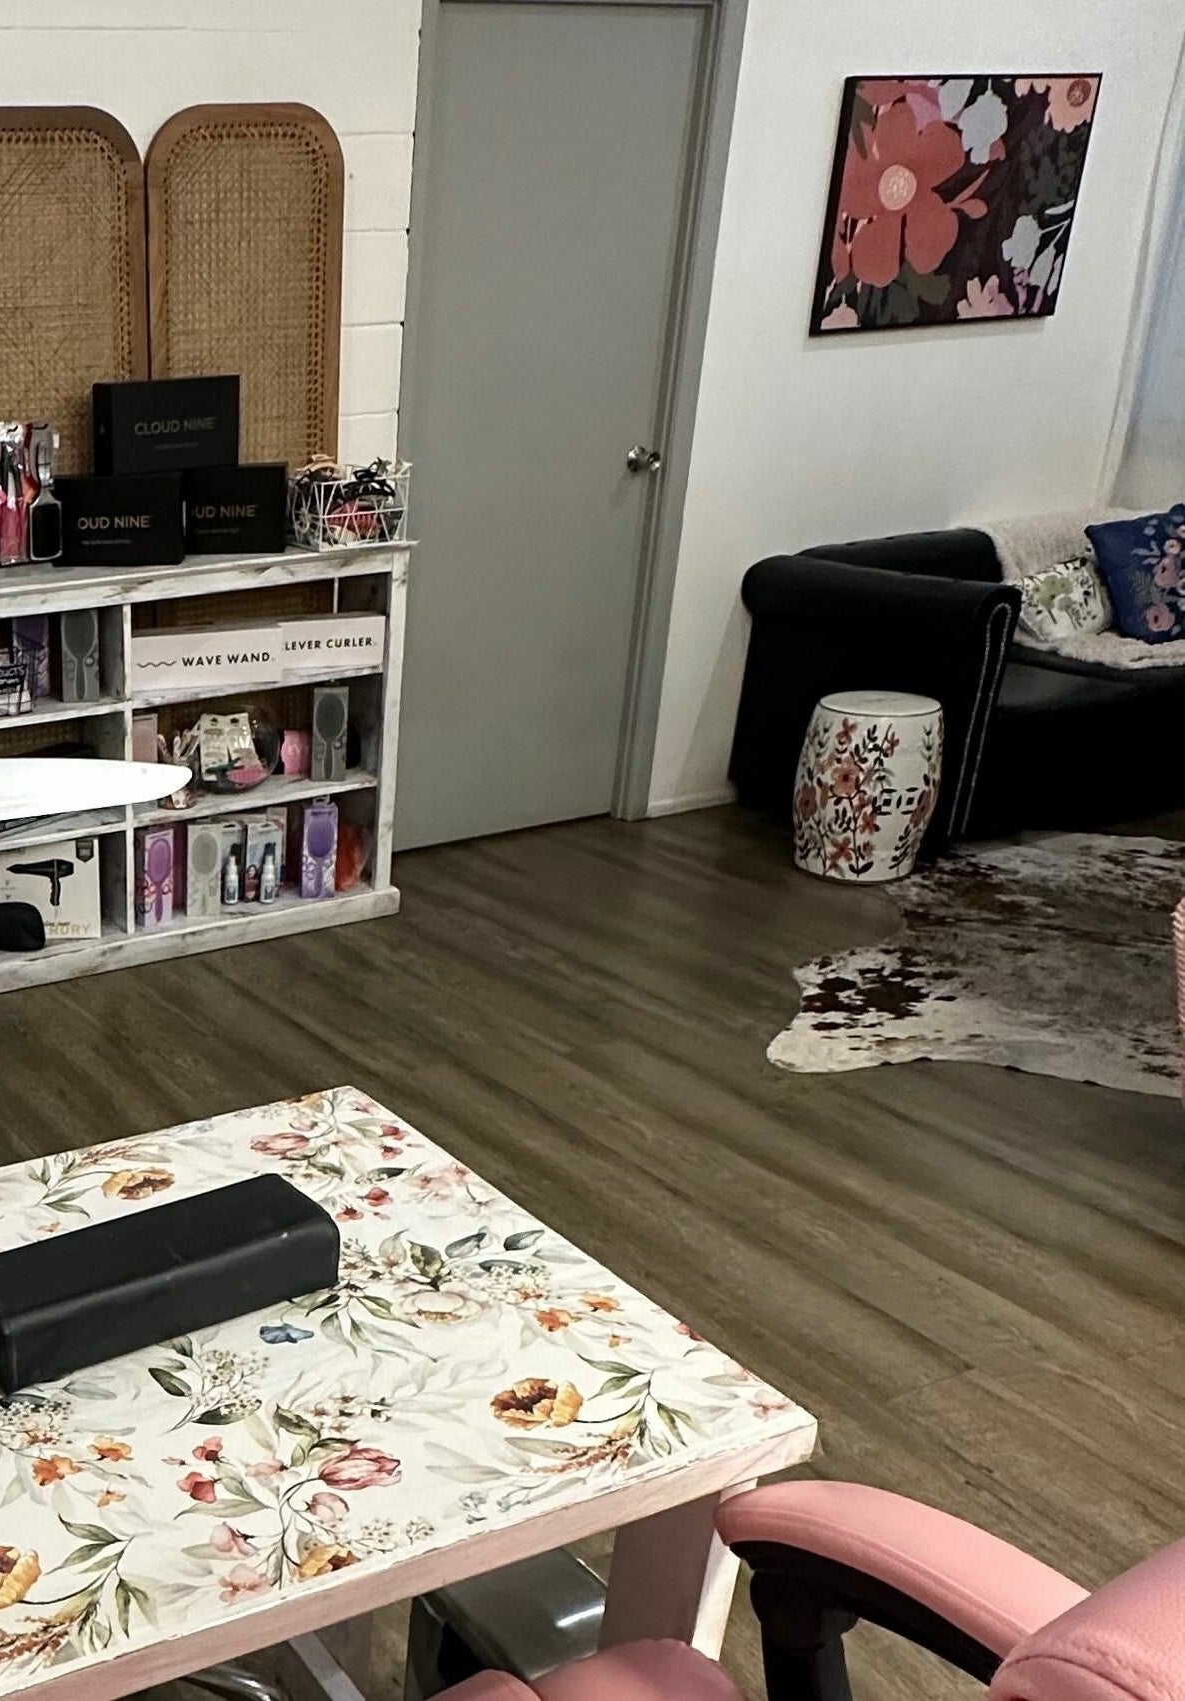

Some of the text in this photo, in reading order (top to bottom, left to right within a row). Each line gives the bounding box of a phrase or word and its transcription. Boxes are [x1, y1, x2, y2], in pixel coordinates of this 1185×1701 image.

[134, 417, 215, 436] CLOUD NINE
[219, 504, 257, 518] NINE
[78, 515, 151, 531] OUD NINE
[182, 655, 223, 667] WAVE
